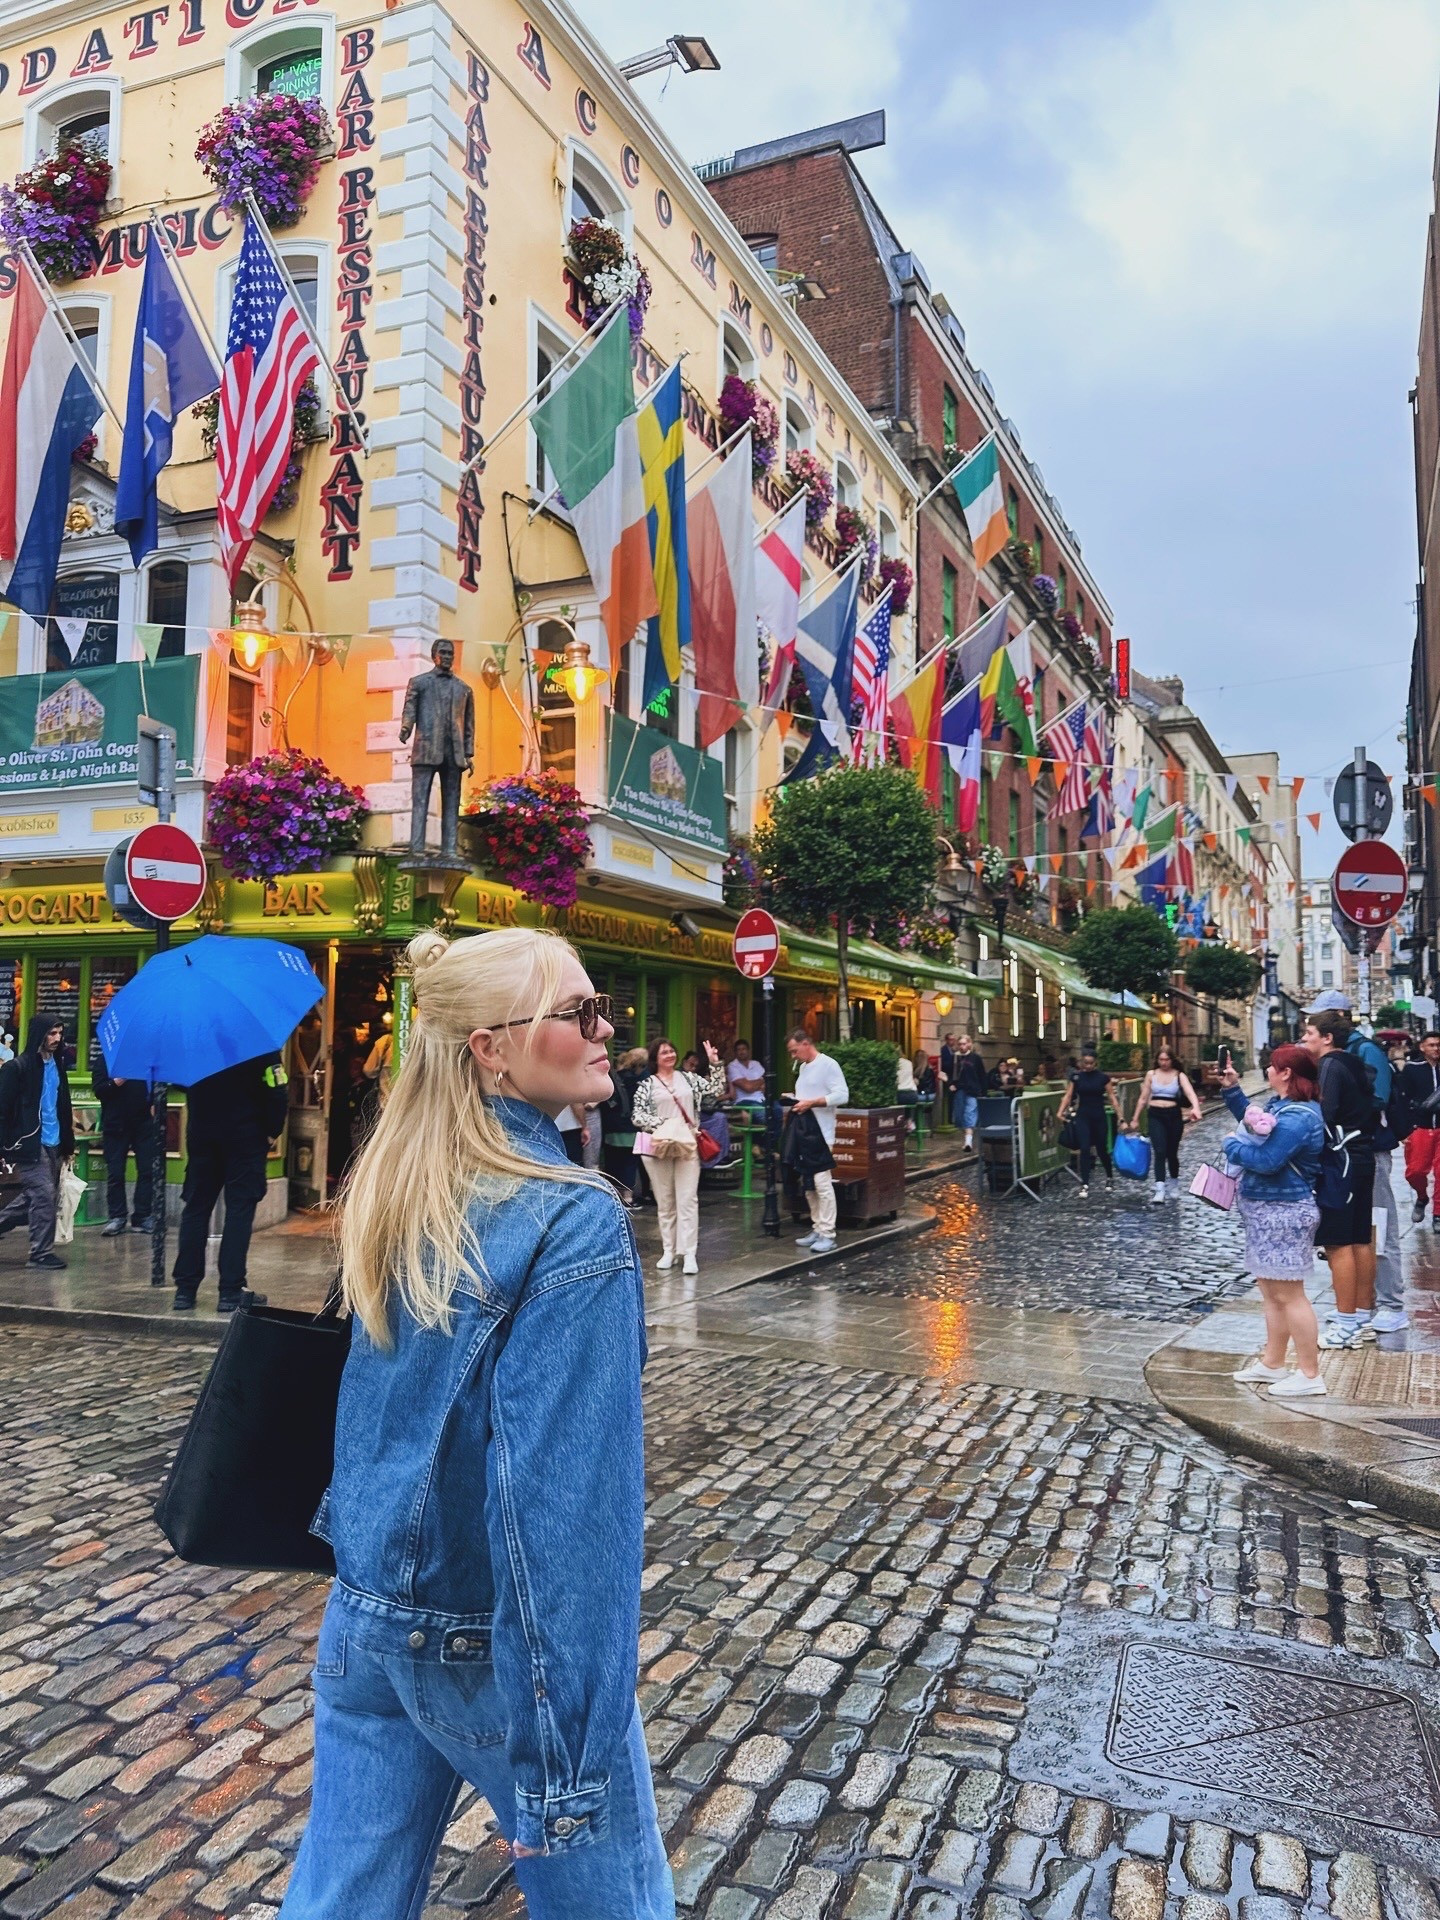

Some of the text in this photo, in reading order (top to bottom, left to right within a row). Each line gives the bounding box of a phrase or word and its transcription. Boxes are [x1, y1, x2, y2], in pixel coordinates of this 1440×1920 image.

[517, 21, 884, 500] ACCOMMODATION
[319, 28, 376, 583] BAR RESTAURANT
[457, 49, 491, 593] BAR RESTAURANT
[84, 624, 109, 642] SIC
[9, 752, 48, 766] Oliver
[50, 750, 68, 762] St.
[71, 745, 103, 763] John
[106, 742, 139, 757] Goga
[0, 769, 37, 784] ssions
[39, 769, 49, 781] &
[52, 768, 78, 783] Late
[80, 763, 116, 780] Night
[623, 785, 638, 801] The
[393, 874, 410, 892] 57
[262, 881, 331, 917] BAR
[392, 895, 411, 914] 58
[476, 890, 519, 927] BAR
[566, 904, 657, 946] RESTAURANT
[702, 935, 735, 963] OLIV
